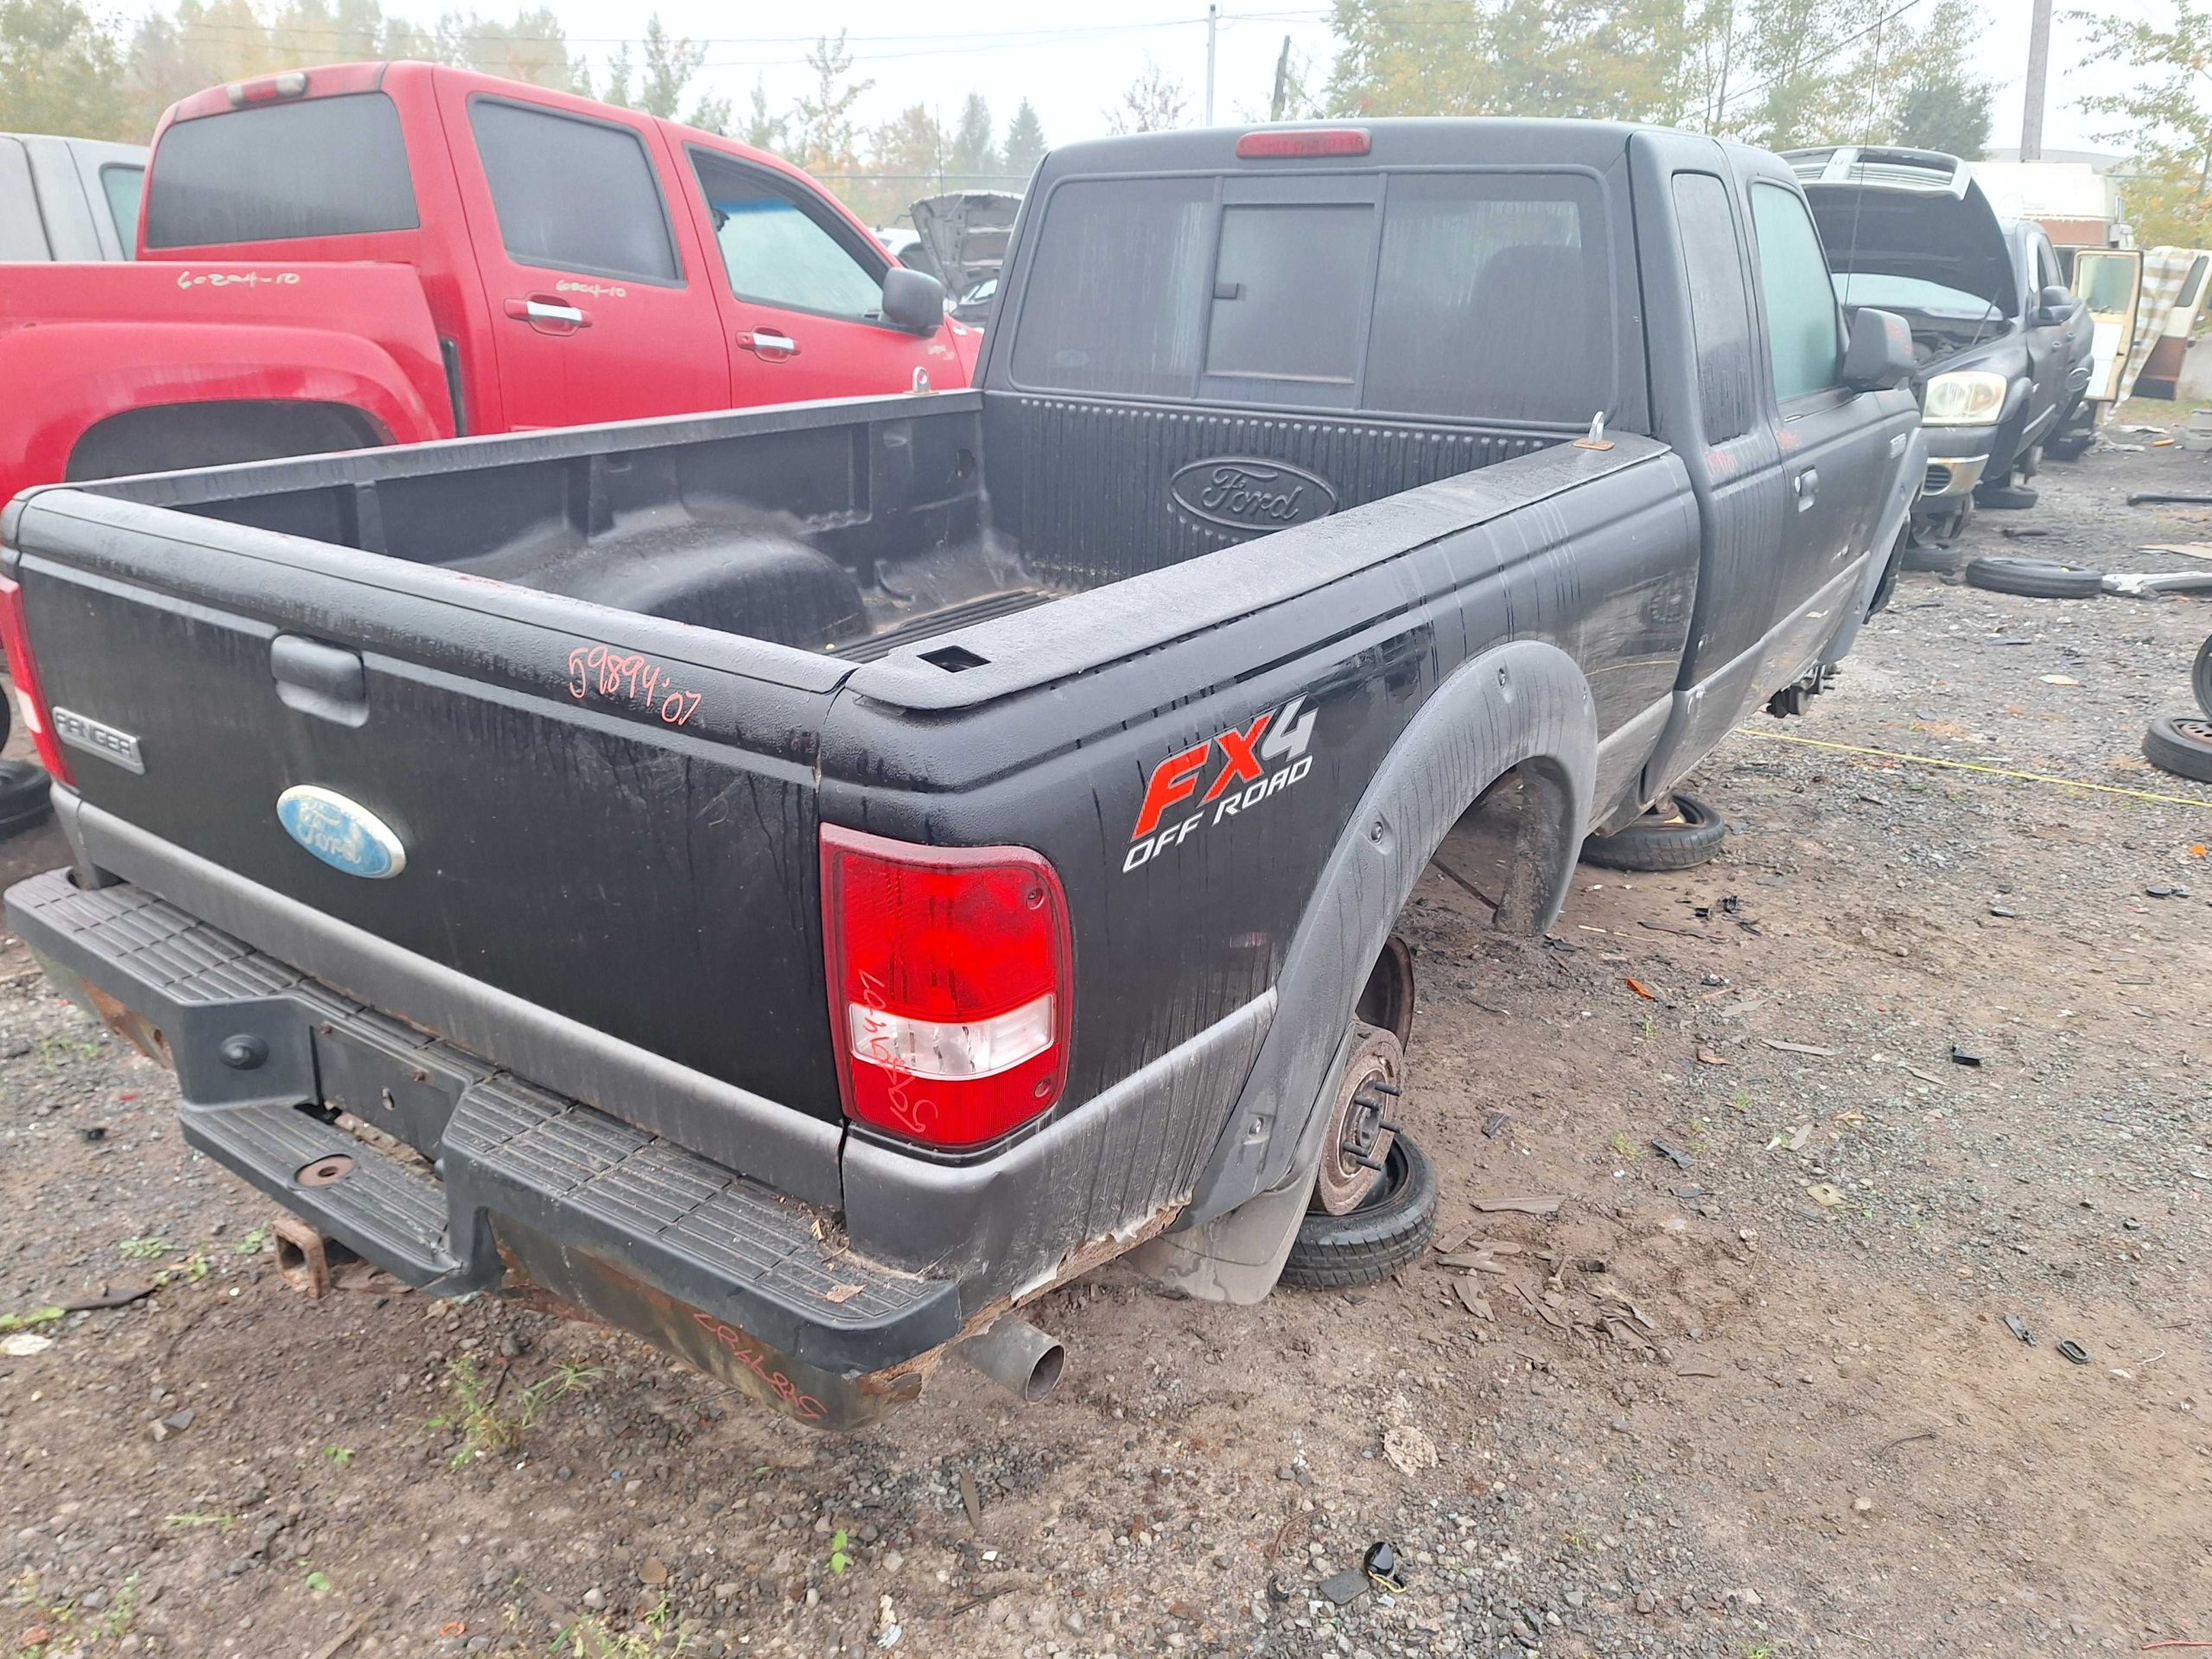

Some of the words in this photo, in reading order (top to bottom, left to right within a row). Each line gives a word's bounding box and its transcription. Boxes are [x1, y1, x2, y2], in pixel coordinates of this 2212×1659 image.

[1202, 467, 1303, 519] Ford
[54, 712, 134, 760] RANGER
[1129, 692, 1319, 843] FX4
[296, 800, 361, 864] Ford
[1122, 809, 1205, 874] OFF
[1211, 753, 1313, 827] ROAD
